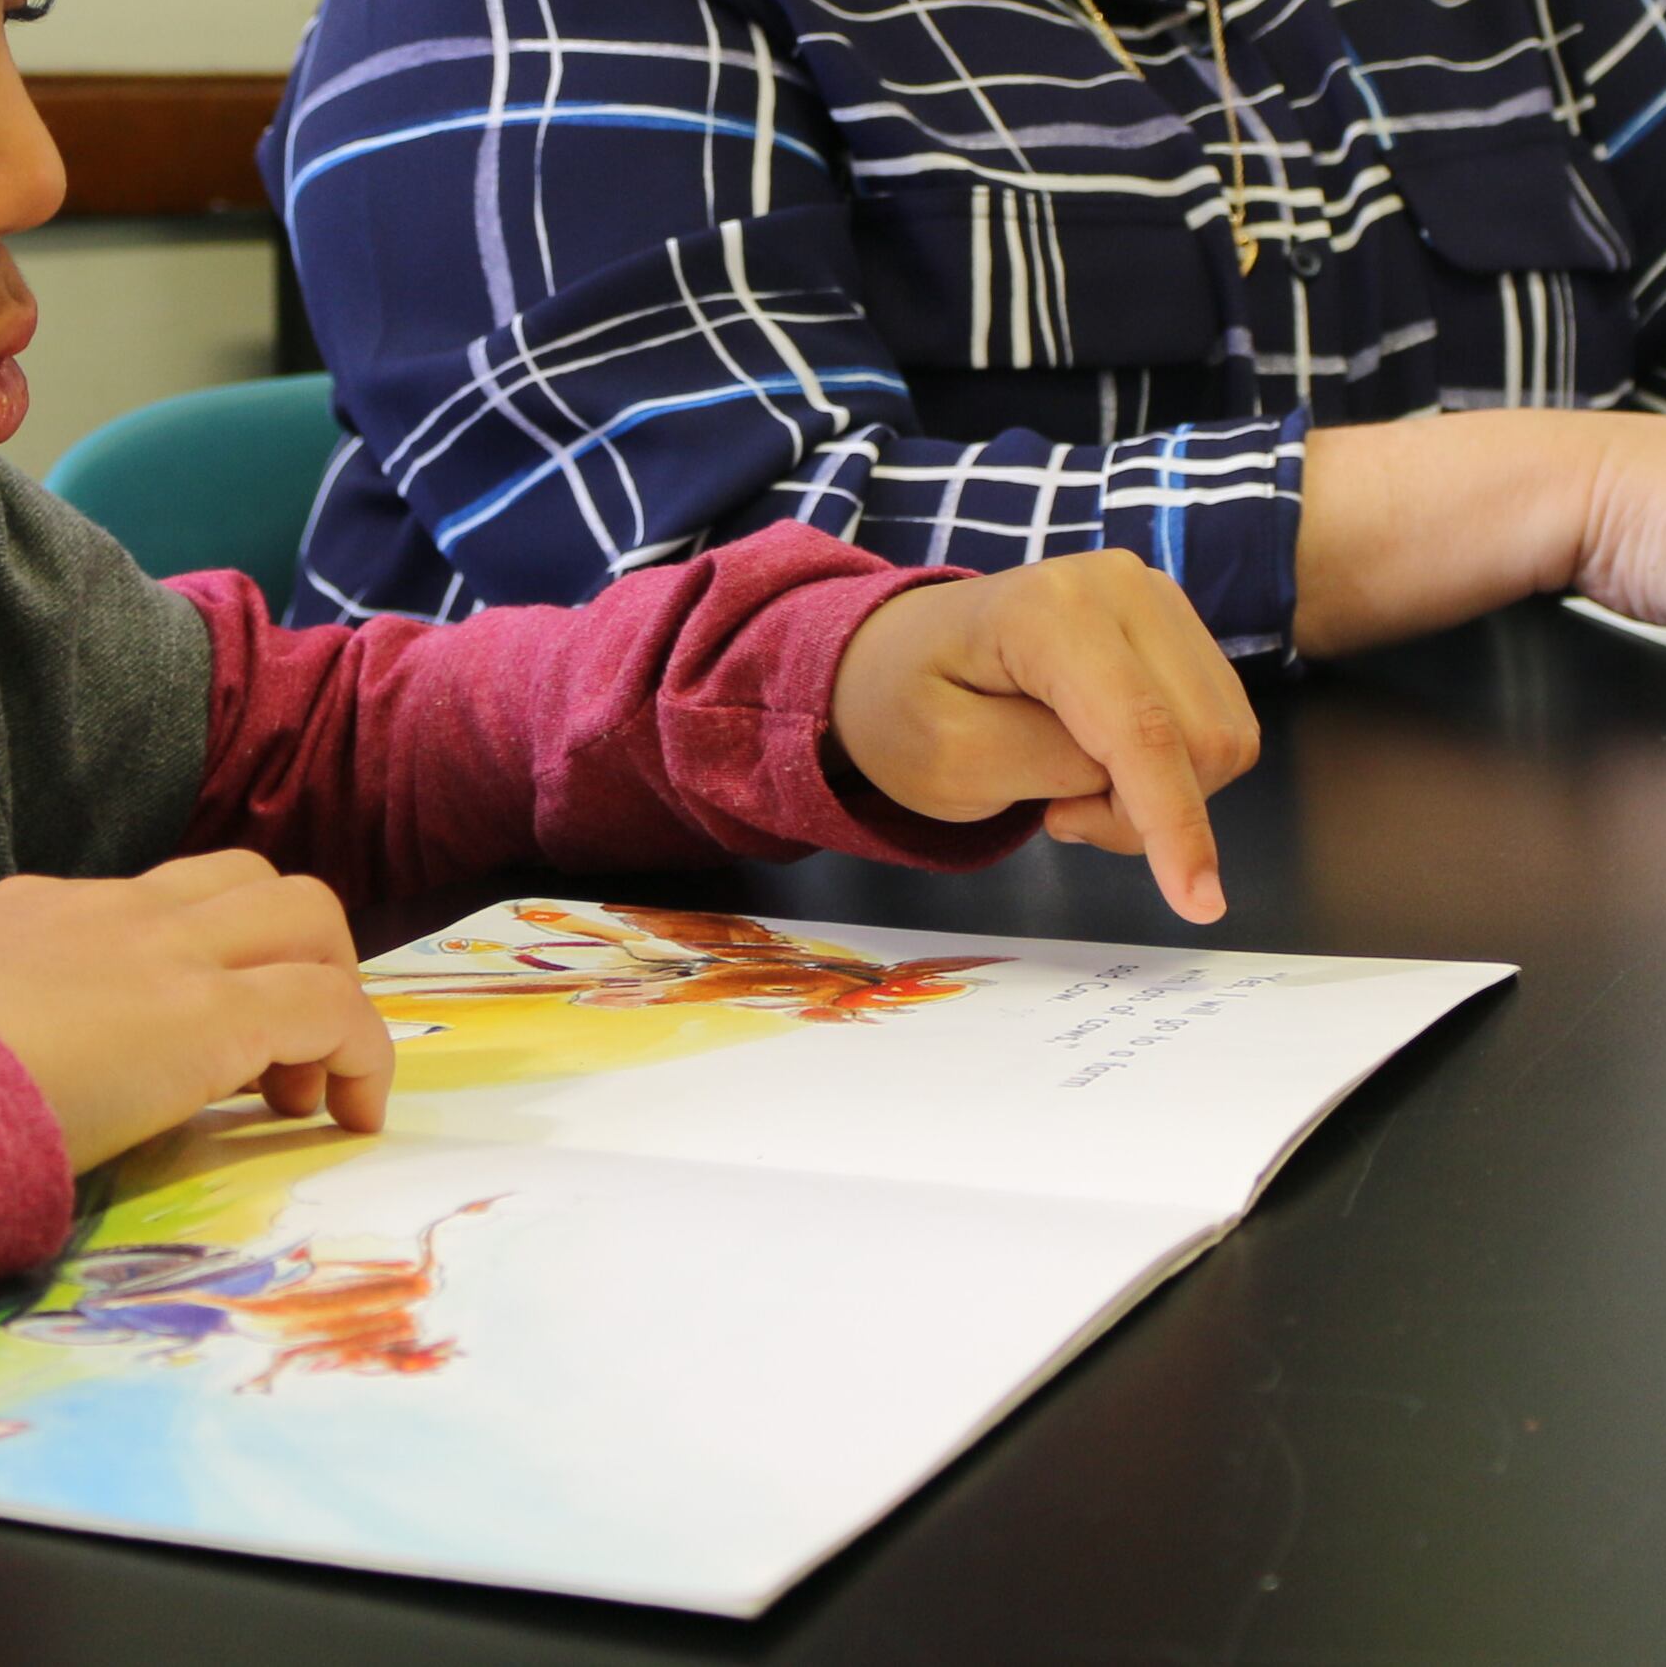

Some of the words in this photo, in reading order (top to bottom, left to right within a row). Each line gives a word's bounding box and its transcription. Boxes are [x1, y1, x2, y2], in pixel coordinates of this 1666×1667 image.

[1161, 968, 1209, 983] with
[1127, 987, 1183, 1001] lots
[1105, 1005, 1136, 1016] of
[1182, 1000, 1224, 1015] will
[1154, 1018, 1189, 1032] go
[1129, 1036, 1172, 1046] to
[1107, 1050, 1135, 1058] a
[1058, 1062, 1128, 1088] farm
